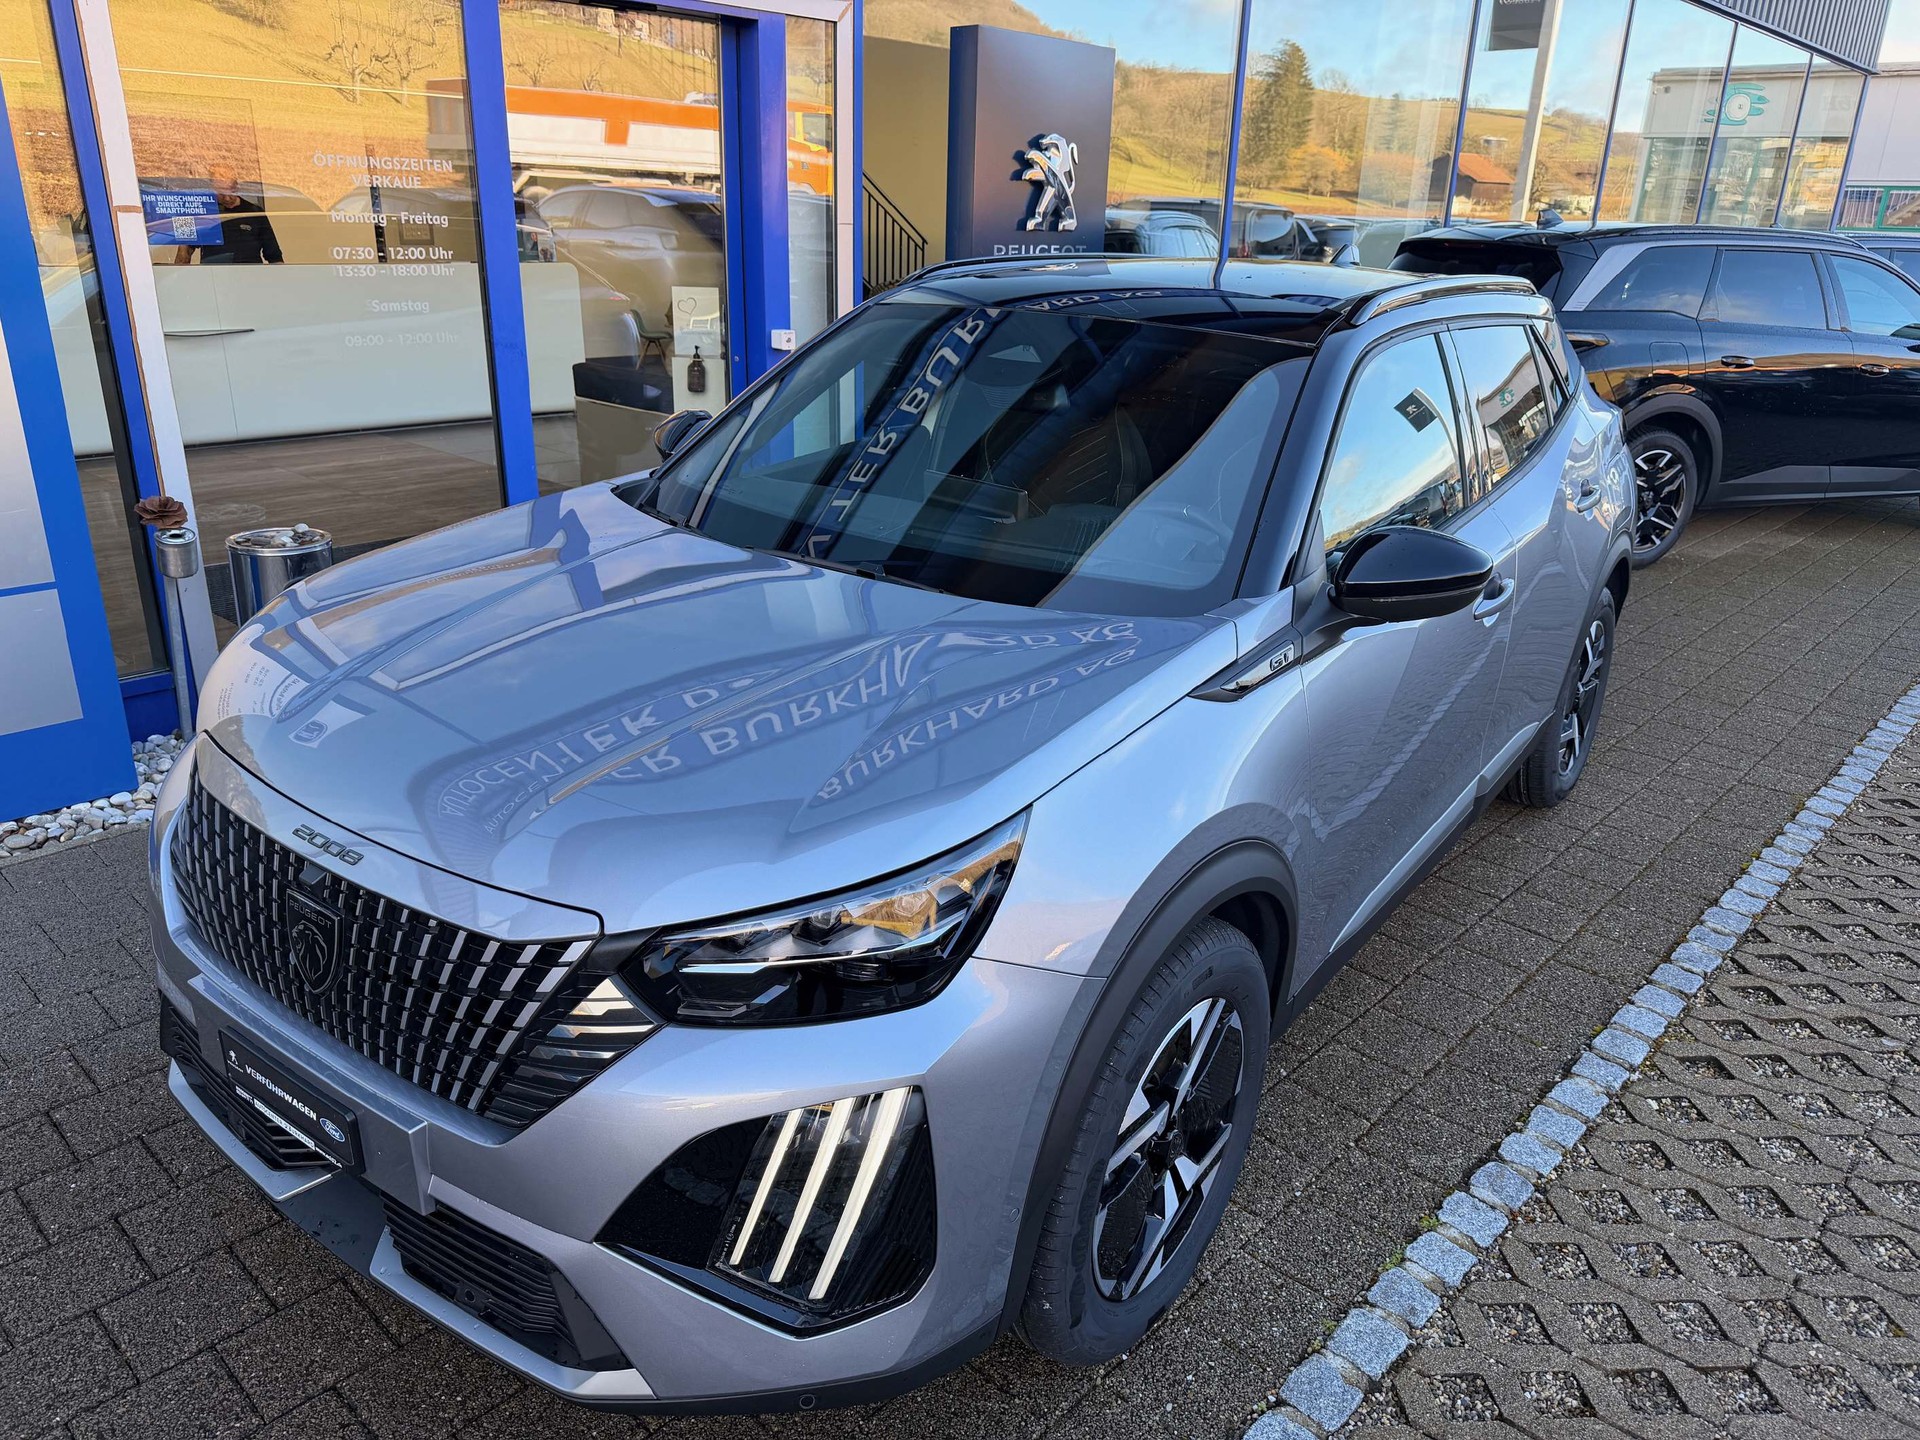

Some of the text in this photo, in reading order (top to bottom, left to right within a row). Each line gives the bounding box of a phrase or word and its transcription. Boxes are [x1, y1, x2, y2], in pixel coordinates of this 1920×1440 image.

[313, 149, 453, 172] ÖFFNUNGSZEITEN
[157, 195, 215, 203] WUNSCHMODELL
[331, 210, 387, 226] Montag
[400, 211, 449, 227] Freitag
[332, 246, 375, 260] 07:30
[388, 246, 426, 260] 12:00
[429, 246, 454, 260] Uhr
[335, 265, 376, 277] 13:30
[391, 265, 427, 277] 18:00
[431, 264, 455, 277] Uhr
[371, 300, 430, 313] Samstag
[345, 335, 384, 347] 09:00
[292, 823, 364, 866] 2008
[289, 899, 332, 929] PEUGEOT
